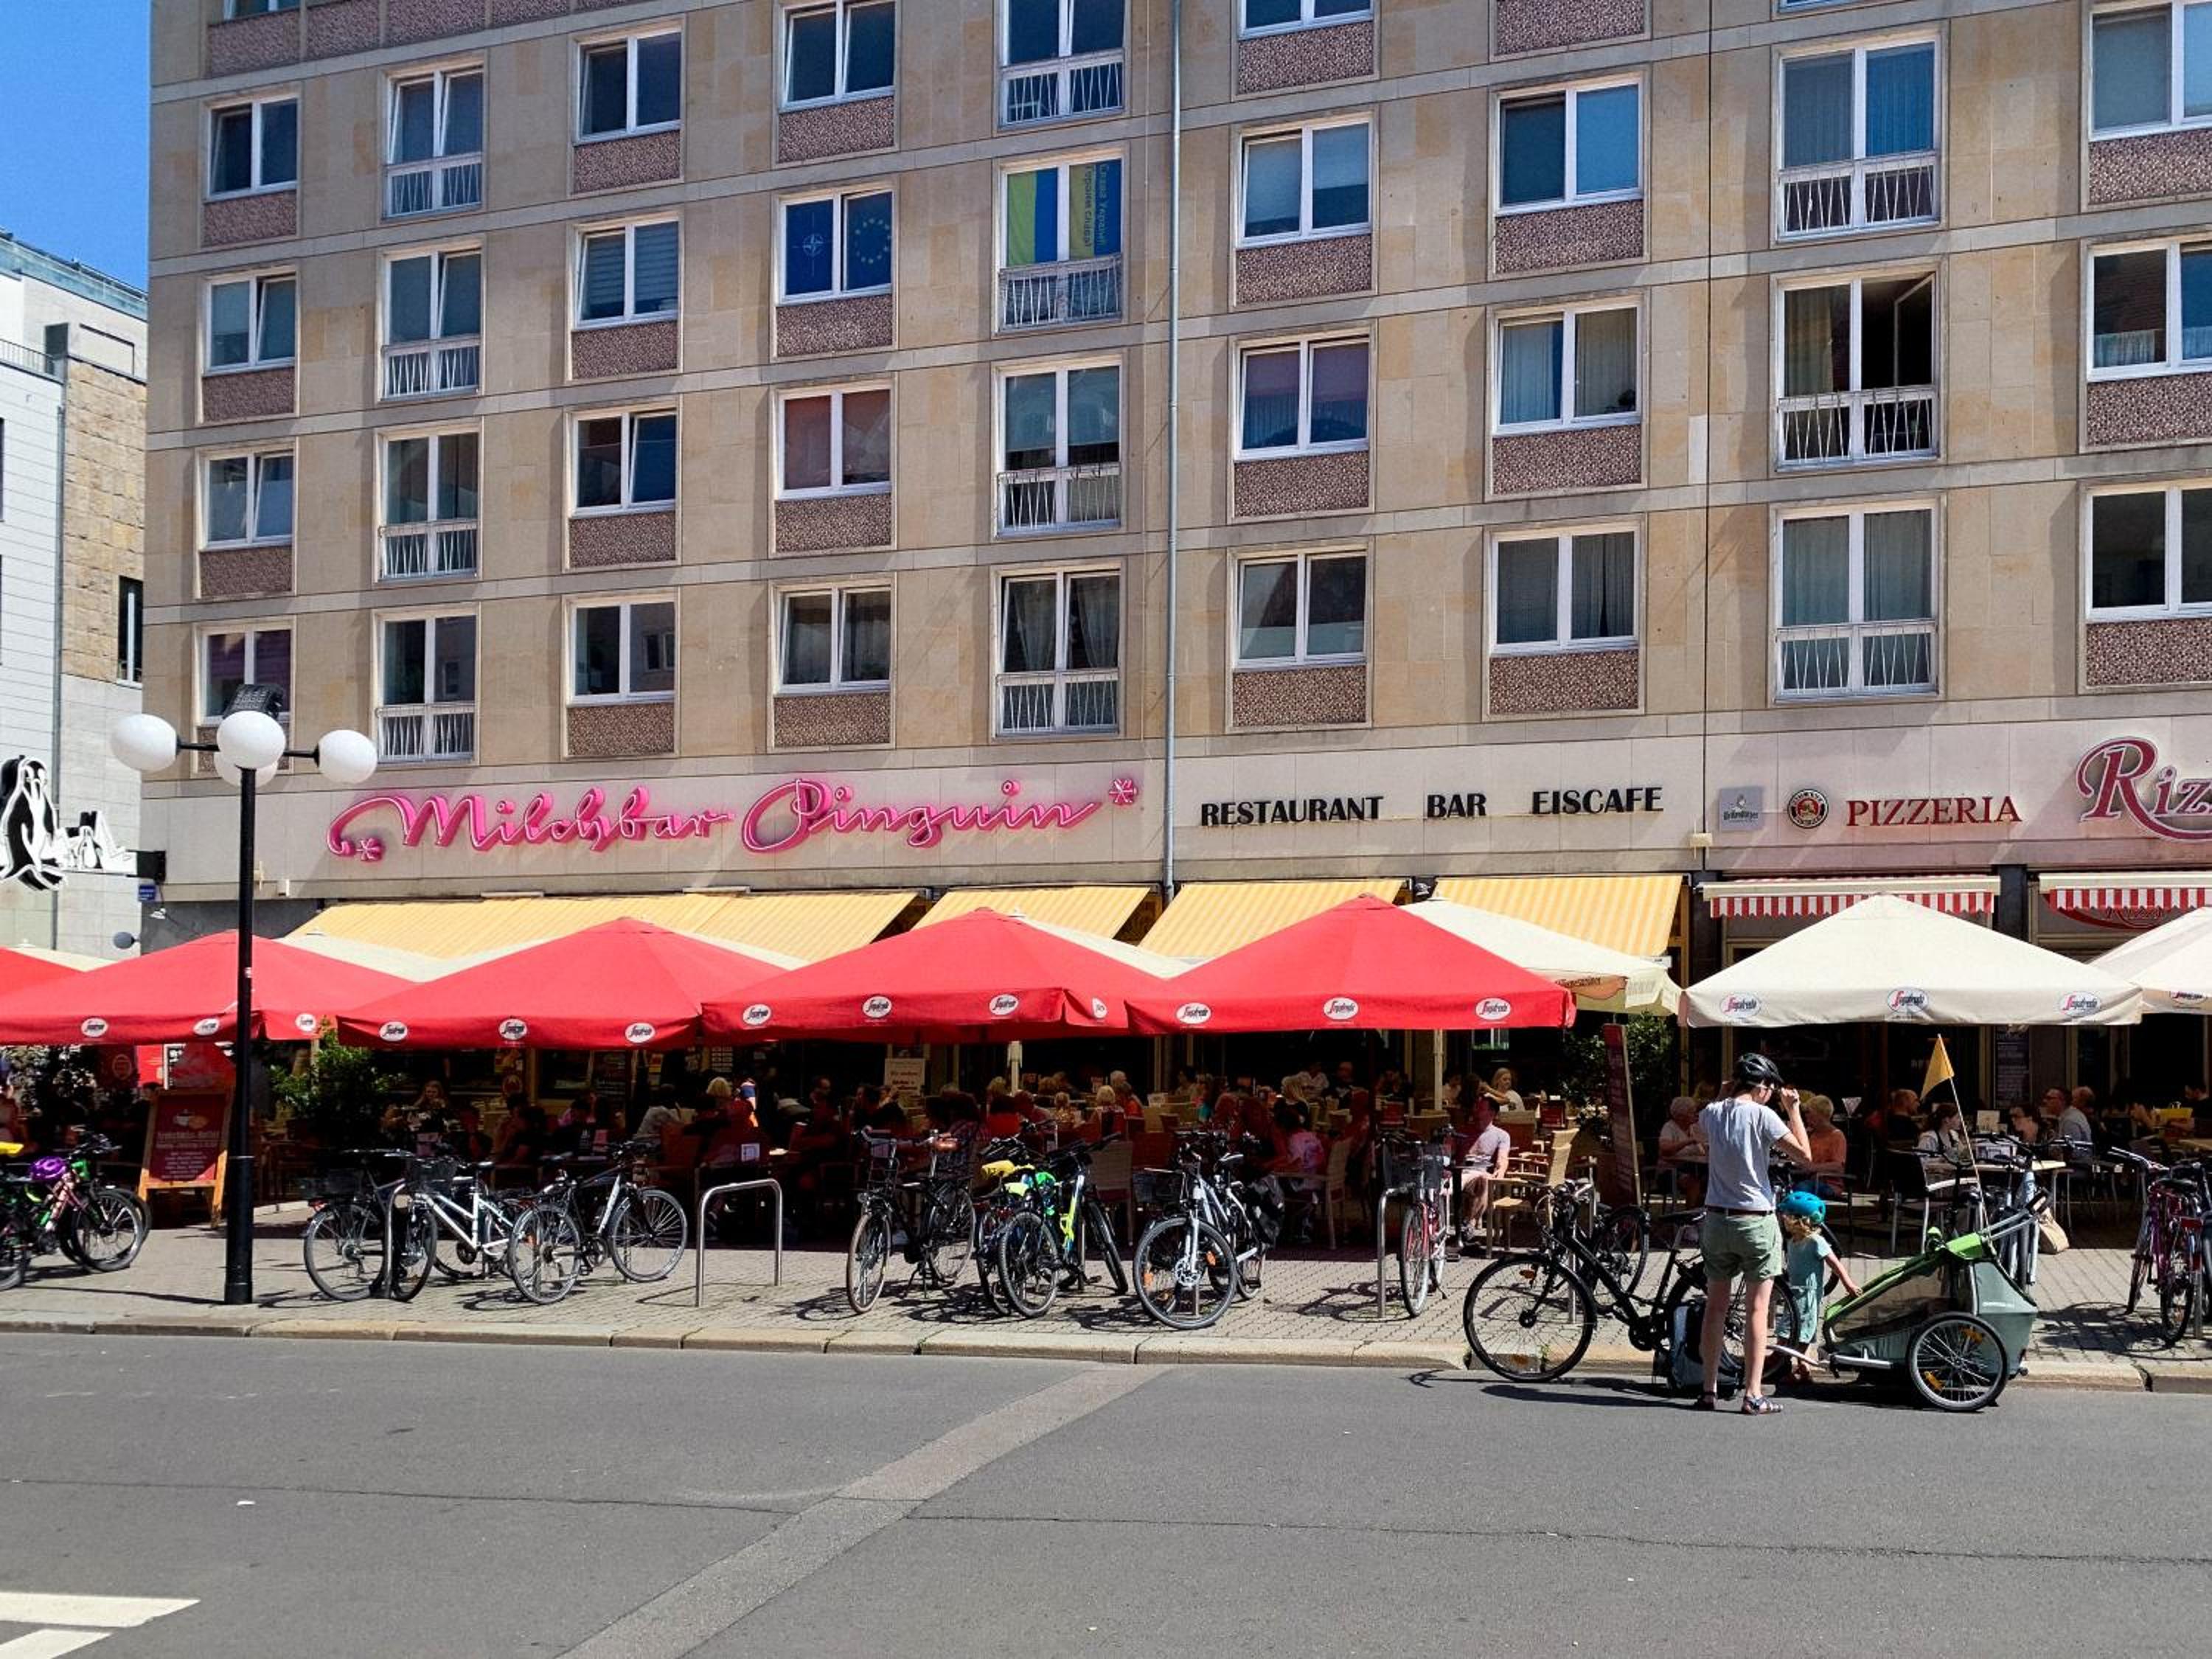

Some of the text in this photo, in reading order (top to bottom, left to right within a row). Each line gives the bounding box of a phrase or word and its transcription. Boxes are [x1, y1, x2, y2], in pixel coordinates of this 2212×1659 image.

[326, 778, 1103, 856] Milchbar Pinguin
[1200, 786, 1663, 827] RESTAURANT BAR EISCAFE
[1846, 796, 2023, 827] PIZZERIA
[2076, 737, 2212, 841] Riz
